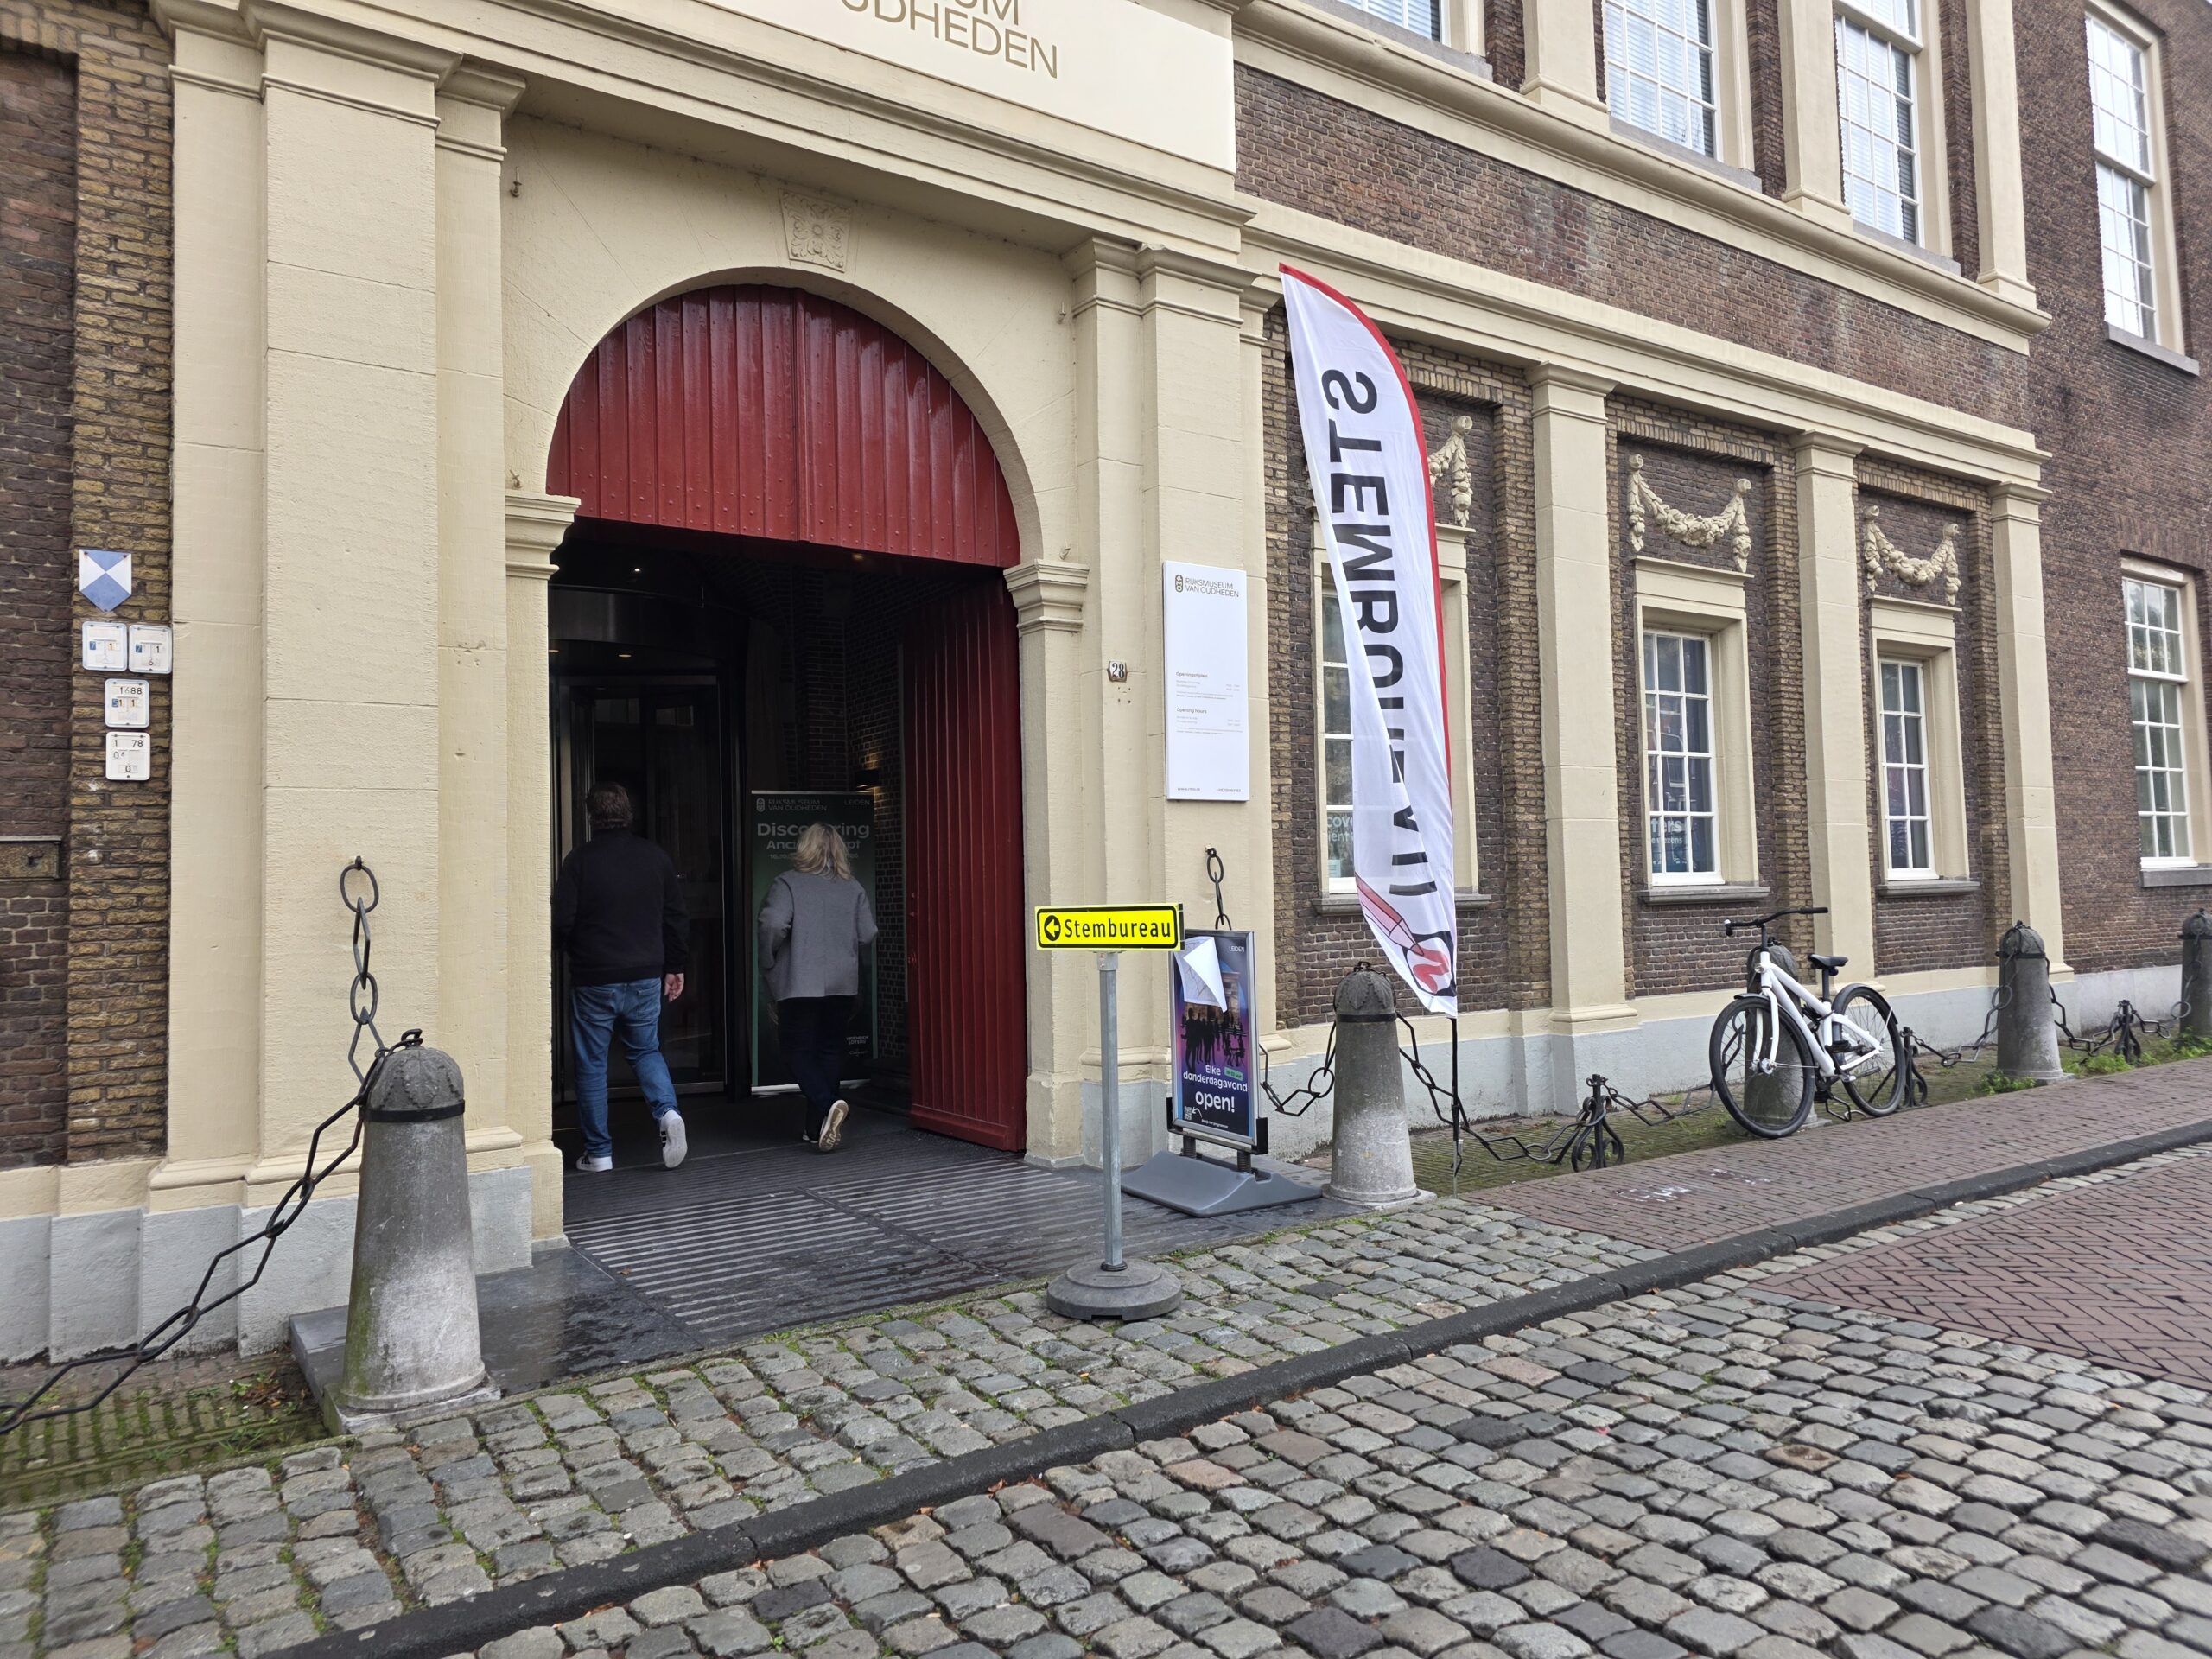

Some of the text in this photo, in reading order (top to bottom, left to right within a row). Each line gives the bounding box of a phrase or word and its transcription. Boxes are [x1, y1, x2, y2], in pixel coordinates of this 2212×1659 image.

[1185, 577, 1233, 590] RIJKSMUSEUM
[1185, 585, 1239, 598] VAN OUDHEDEN
[1112, 663, 1125, 678] 28
[1065, 918, 1171, 938] Stembureau
[1205, 1065, 1221, 1076] Elke
[1183, 1071, 1248, 1092] donderdagavond
[1195, 1091, 1235, 1113] open!
